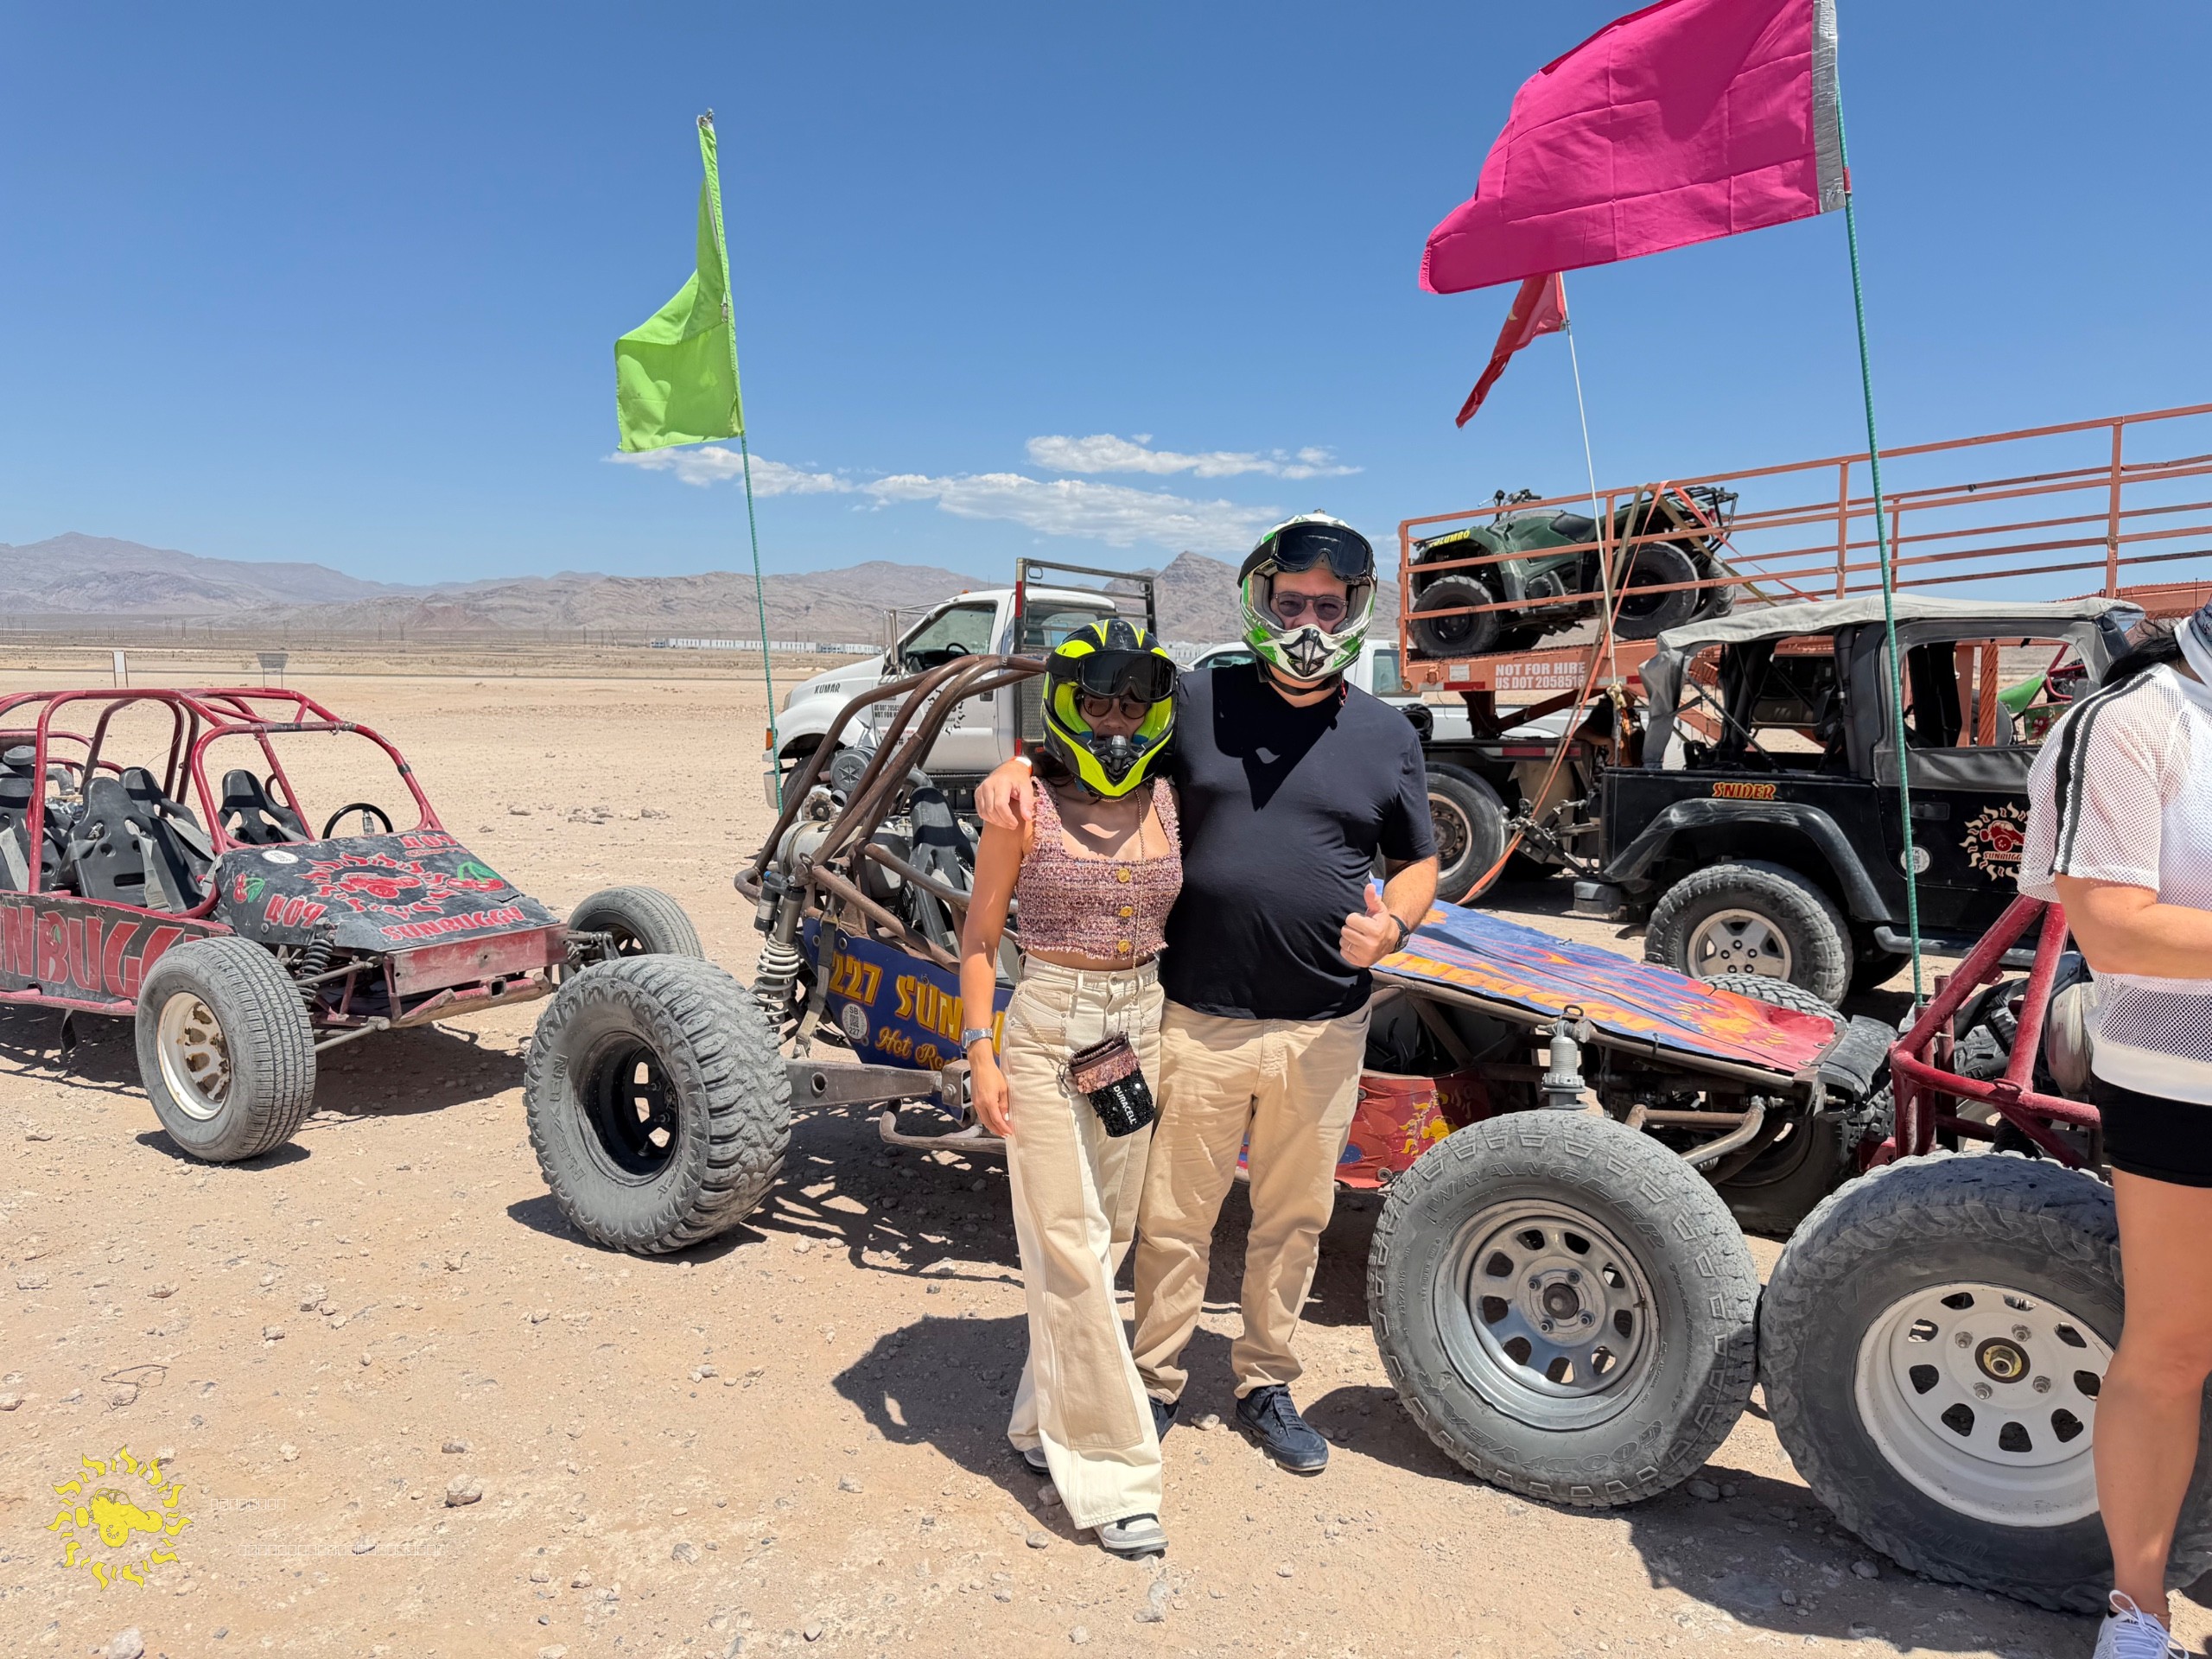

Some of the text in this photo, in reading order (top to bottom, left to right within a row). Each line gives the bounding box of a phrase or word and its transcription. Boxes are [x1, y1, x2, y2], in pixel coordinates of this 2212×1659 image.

[1496, 661, 1586, 676] NOT FOR HIRE
[815, 683, 841, 694] KUMAR
[1496, 677, 1510, 689] US
[1512, 677, 1534, 689] DOT
[1712, 781, 1777, 800] SNIDER
[397, 834, 458, 849] 409
[1983, 851, 2023, 862] SUNBUGG
[264, 893, 328, 928] 409
[379, 906, 526, 941] SUNBUGGY
[829, 952, 884, 1007] 227
[849, 1006, 859, 1015] SB
[849, 1027, 860, 1036] 227
[874, 1026, 961, 1071] Hot Ro
[1113, 1084, 1137, 1125] DURACELL
[1428, 1160, 1667, 1251] WRANGLER
[1417, 1370, 1665, 1473] GOODYEAR
